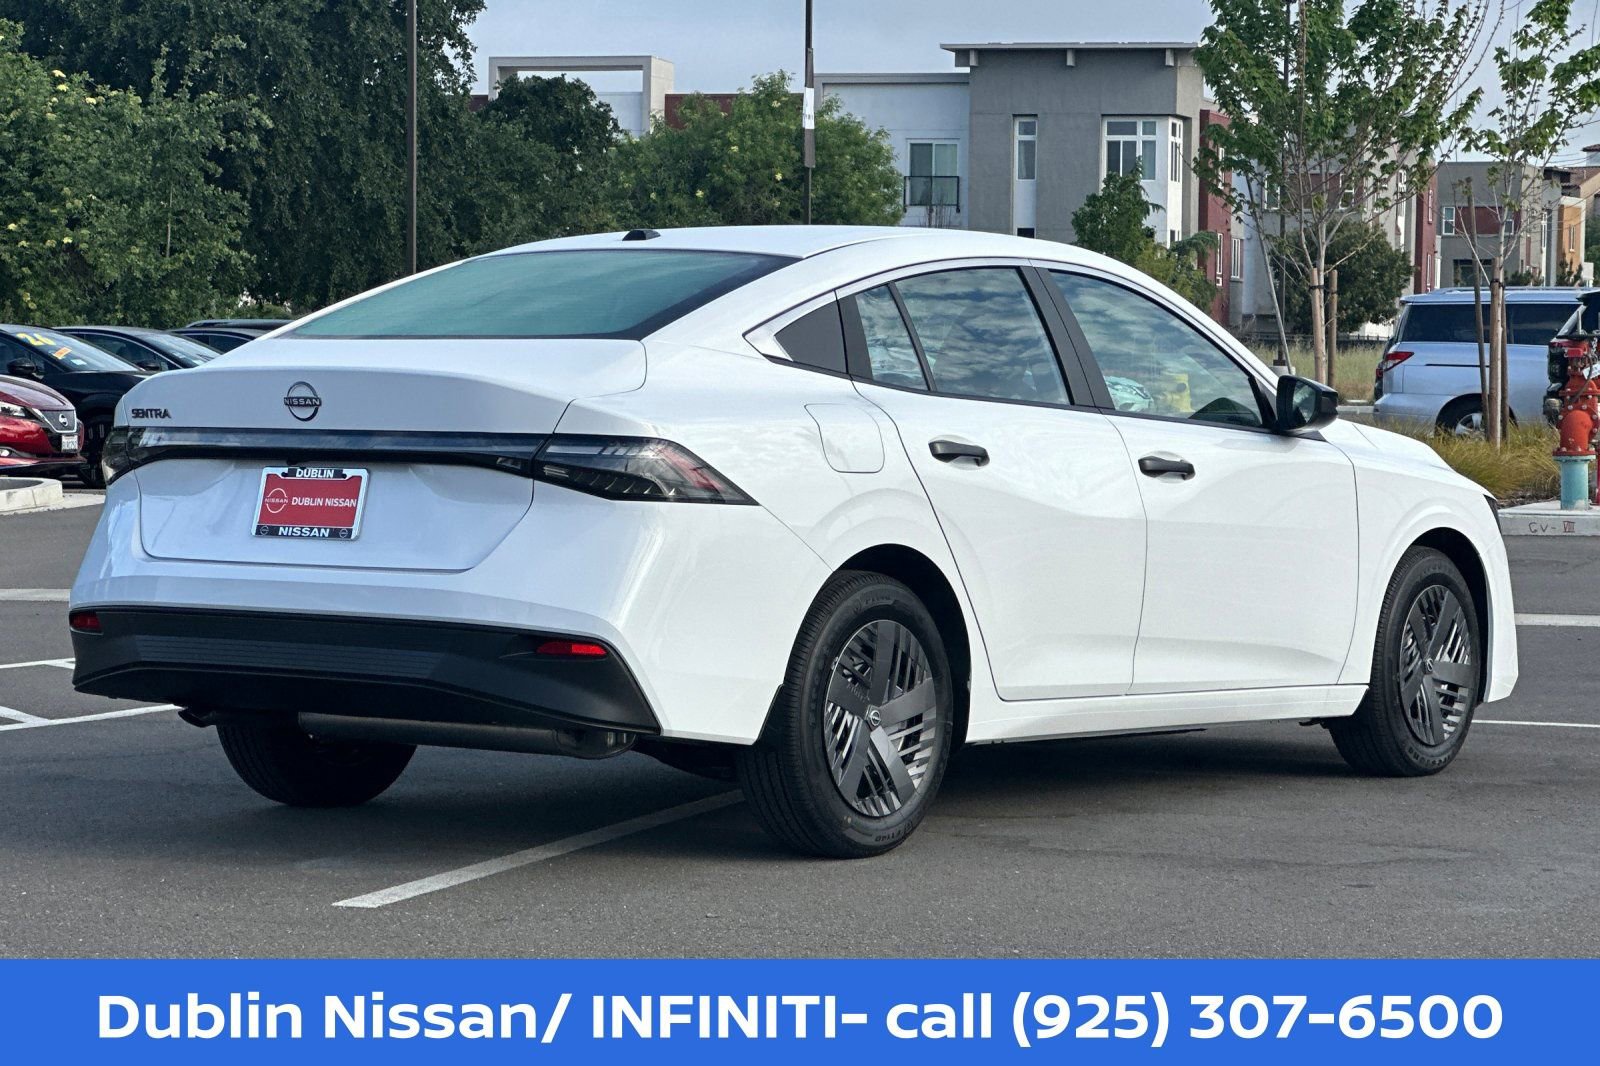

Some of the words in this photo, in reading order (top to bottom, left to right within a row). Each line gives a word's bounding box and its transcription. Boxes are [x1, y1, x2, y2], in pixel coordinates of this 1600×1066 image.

[131, 408, 172, 419] SENTRA
[295, 468, 335, 479] DUBLIN
[291, 497, 324, 506] DUBLIN
[324, 498, 357, 507] NISSAN
[278, 527, 330, 538] NISSAN
